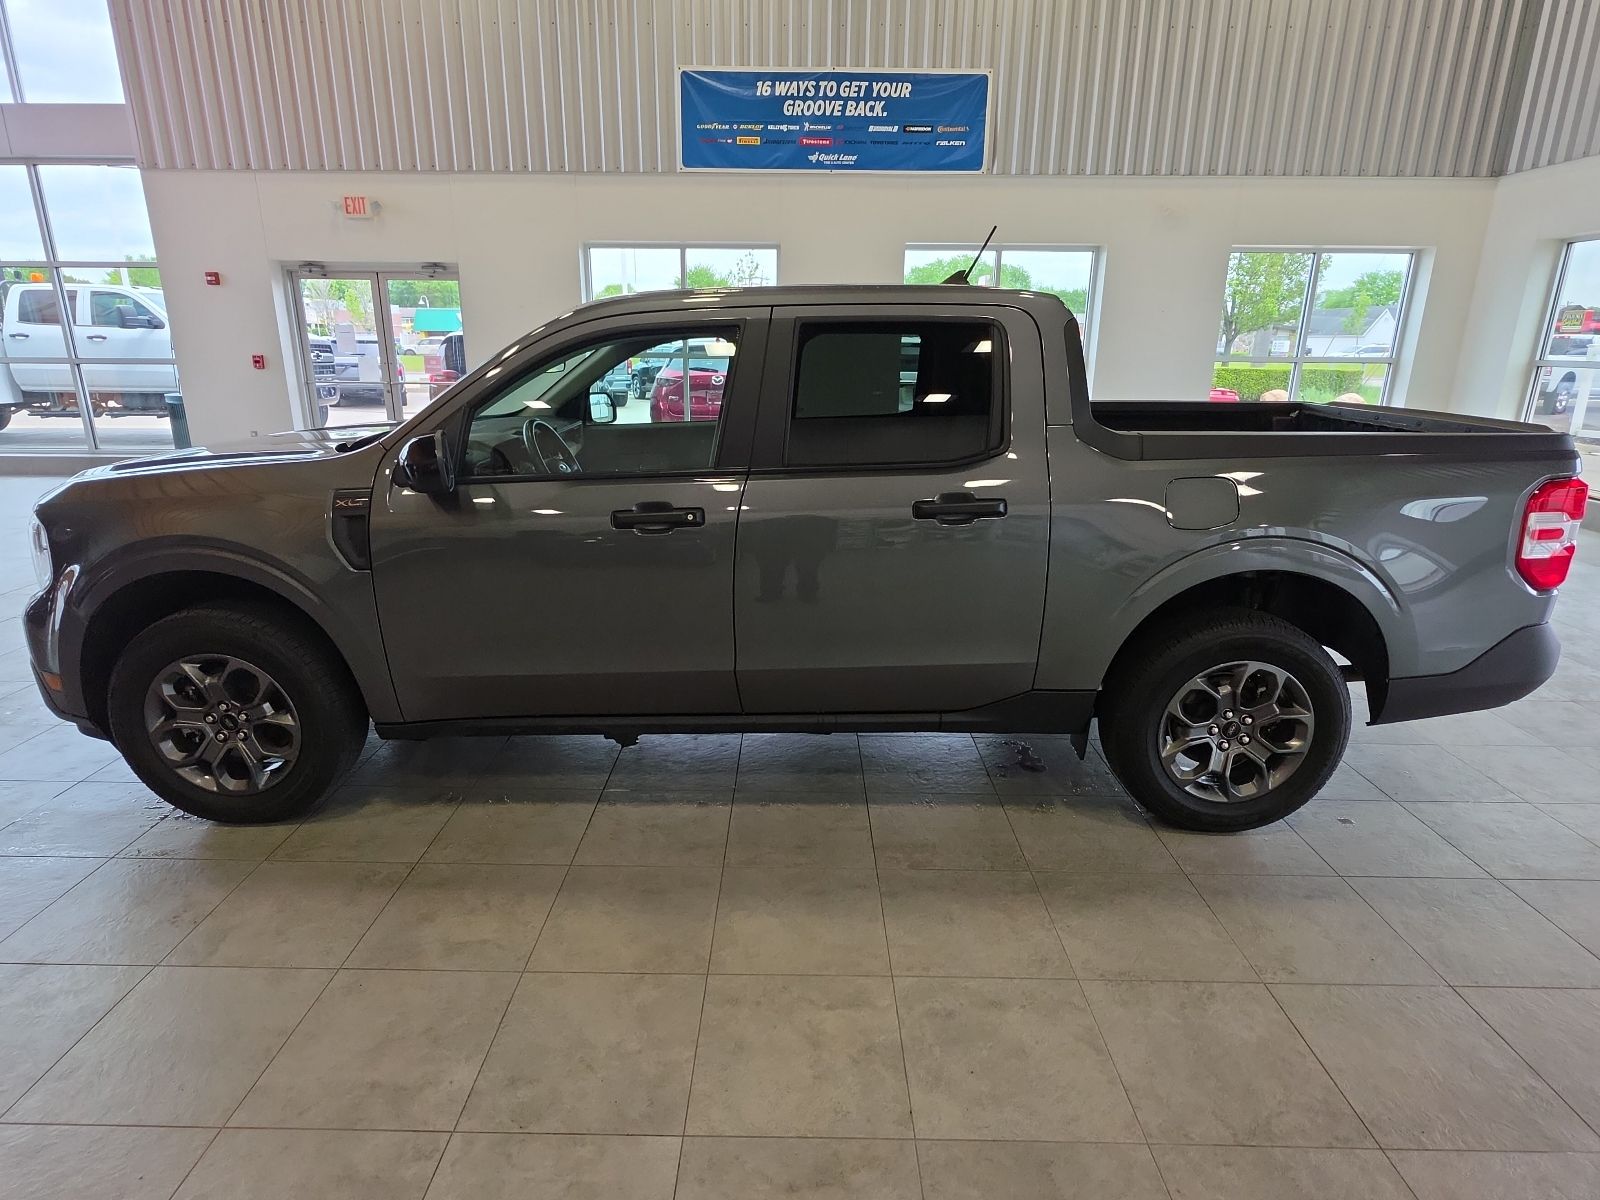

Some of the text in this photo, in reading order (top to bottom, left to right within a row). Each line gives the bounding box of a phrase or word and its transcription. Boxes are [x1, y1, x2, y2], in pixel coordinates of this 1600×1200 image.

[756, 80, 912, 99] 16 WAYS TO GET YOUR
[783, 99, 888, 118] GROOVE BACK.
[344, 196, 366, 215] EXIT
